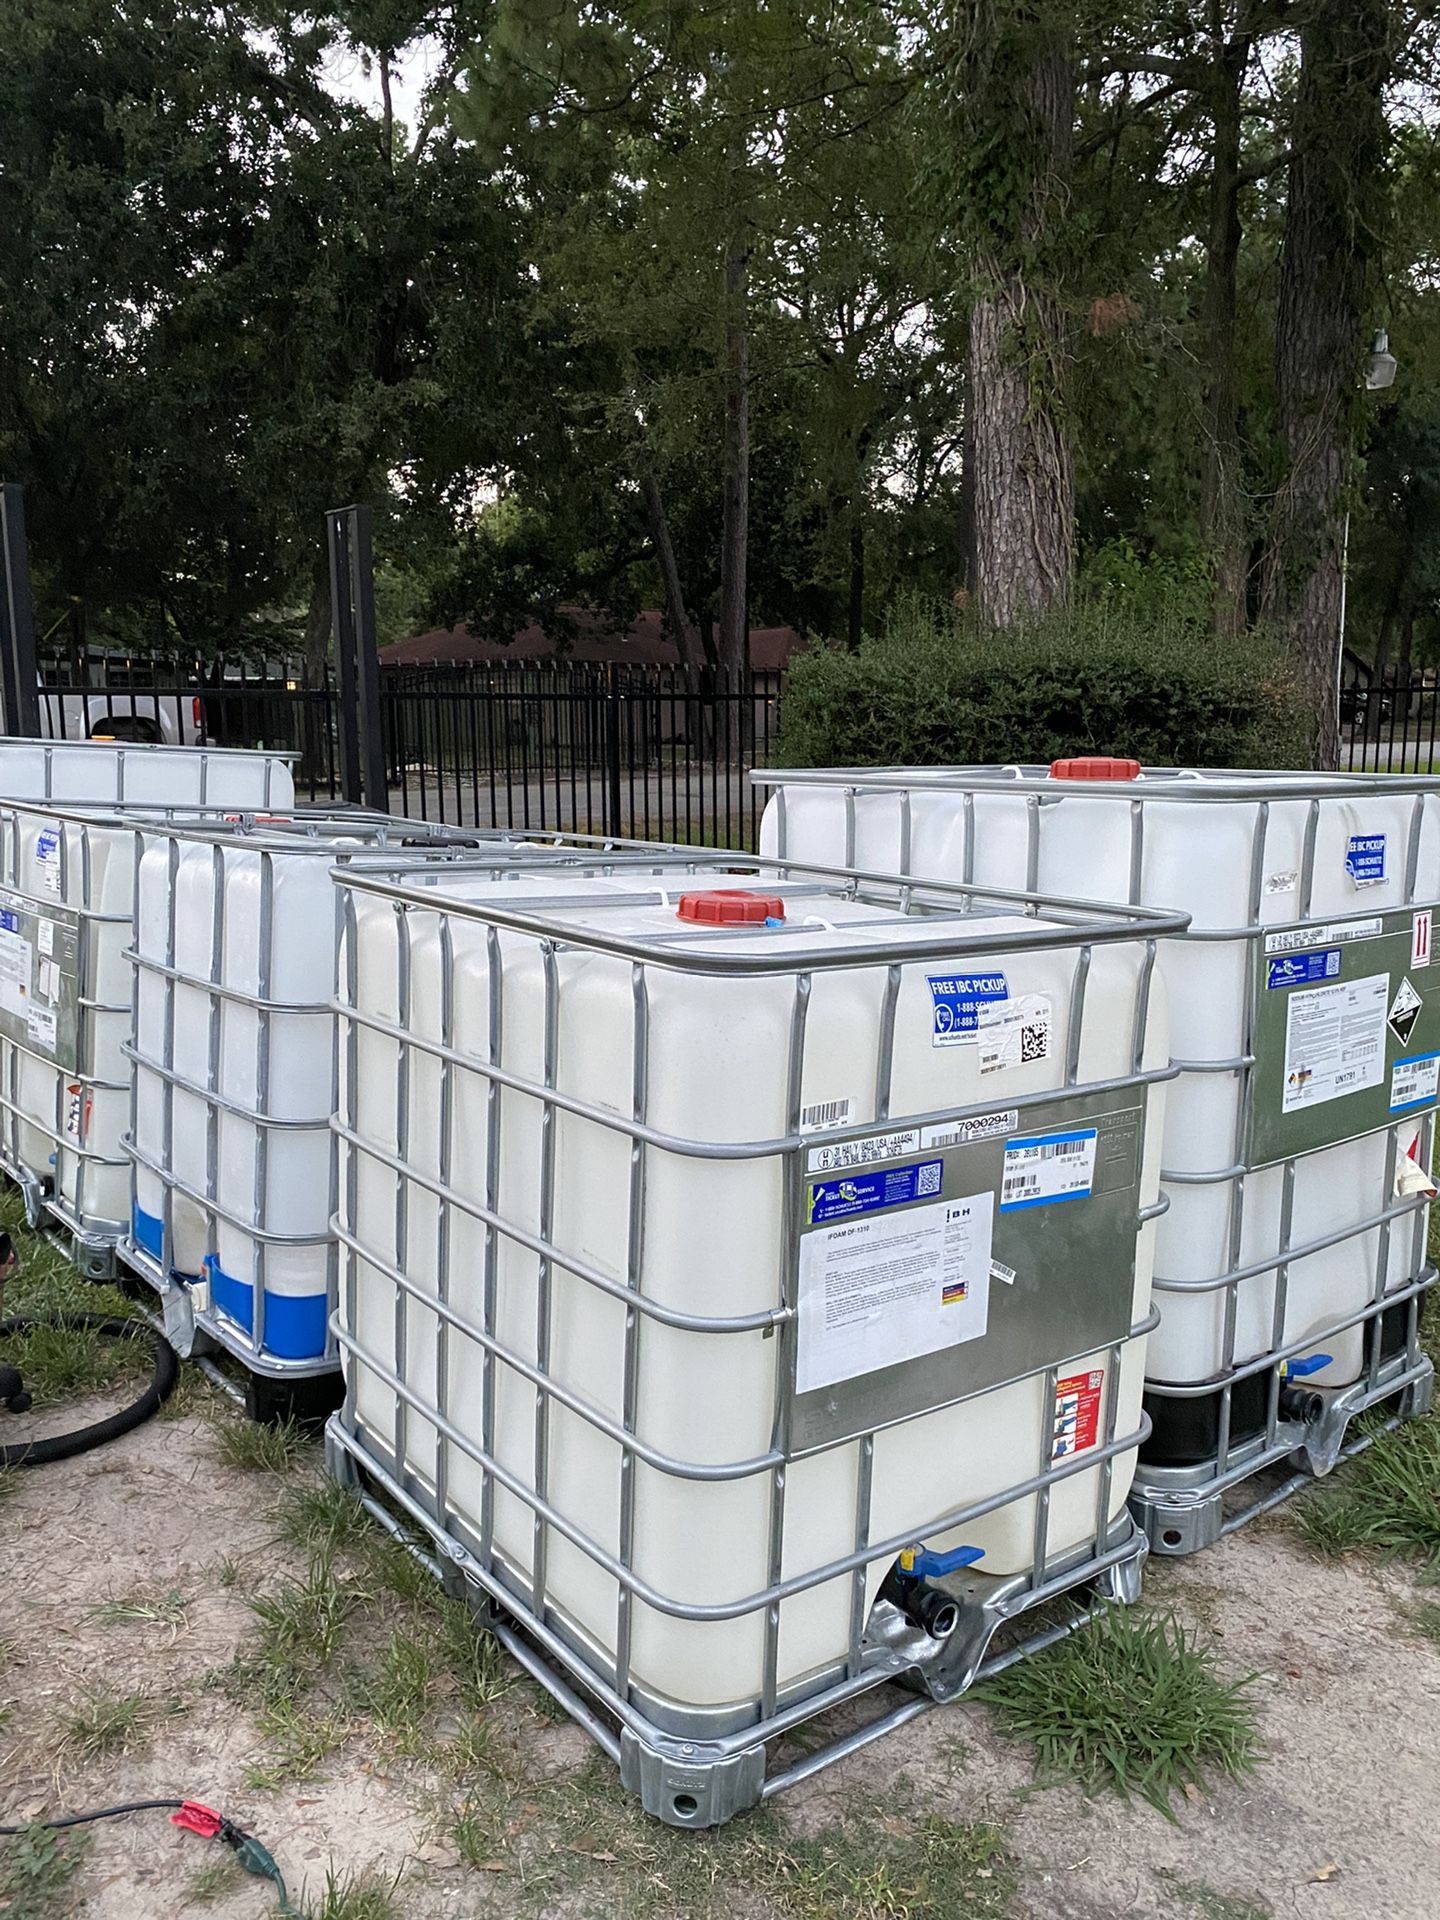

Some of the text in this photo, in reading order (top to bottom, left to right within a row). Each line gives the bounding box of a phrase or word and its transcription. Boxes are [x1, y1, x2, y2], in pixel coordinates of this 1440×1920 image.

[1366, 840, 1385, 851] PICKUP
[931, 978, 1006, 995] FREE IBC PICKUP
[1335, 1071, 1356, 1085] UN1791
[957, 1113, 1009, 1132] 7000294
[828, 1225, 870, 1240] IFOAM DF-1310
